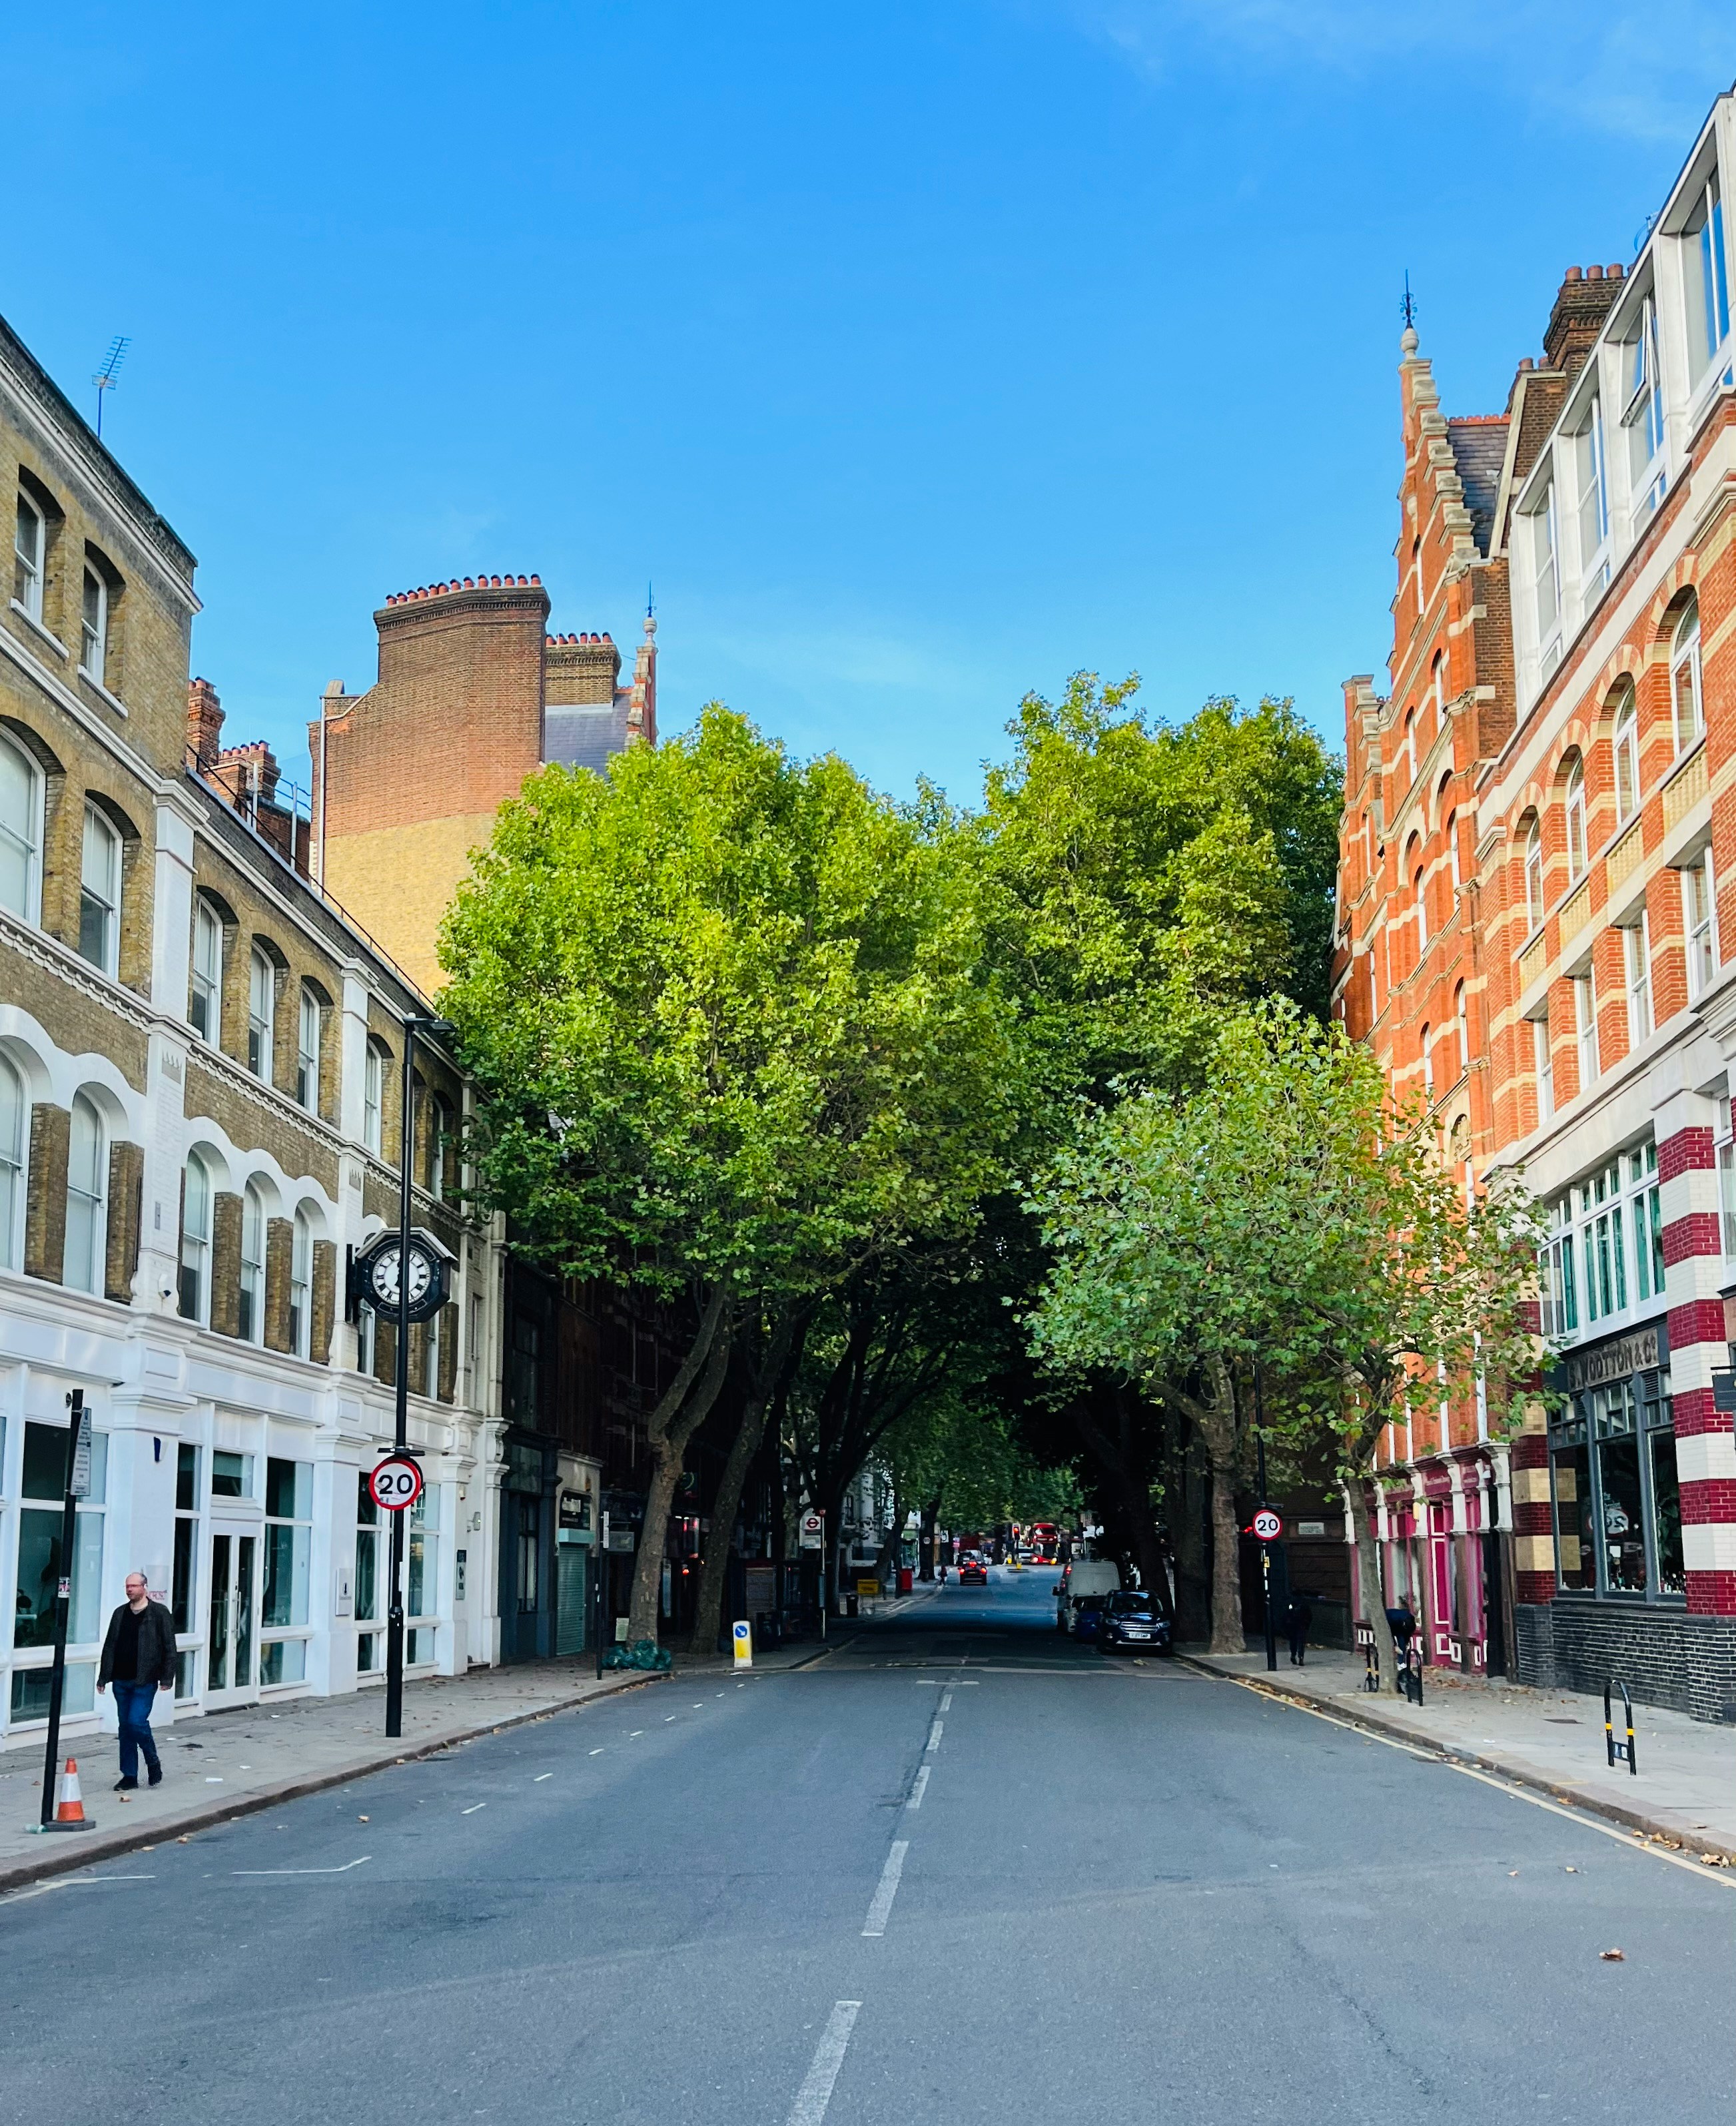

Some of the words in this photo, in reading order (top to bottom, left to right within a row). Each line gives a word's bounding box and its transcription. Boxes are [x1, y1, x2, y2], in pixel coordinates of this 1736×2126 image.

[1580, 1343, 1633, 1383] WOOTTON
[1635, 1342, 1643, 1366] &
[378, 1474, 413, 1495] 20
[1257, 1519, 1278, 1531] 20
